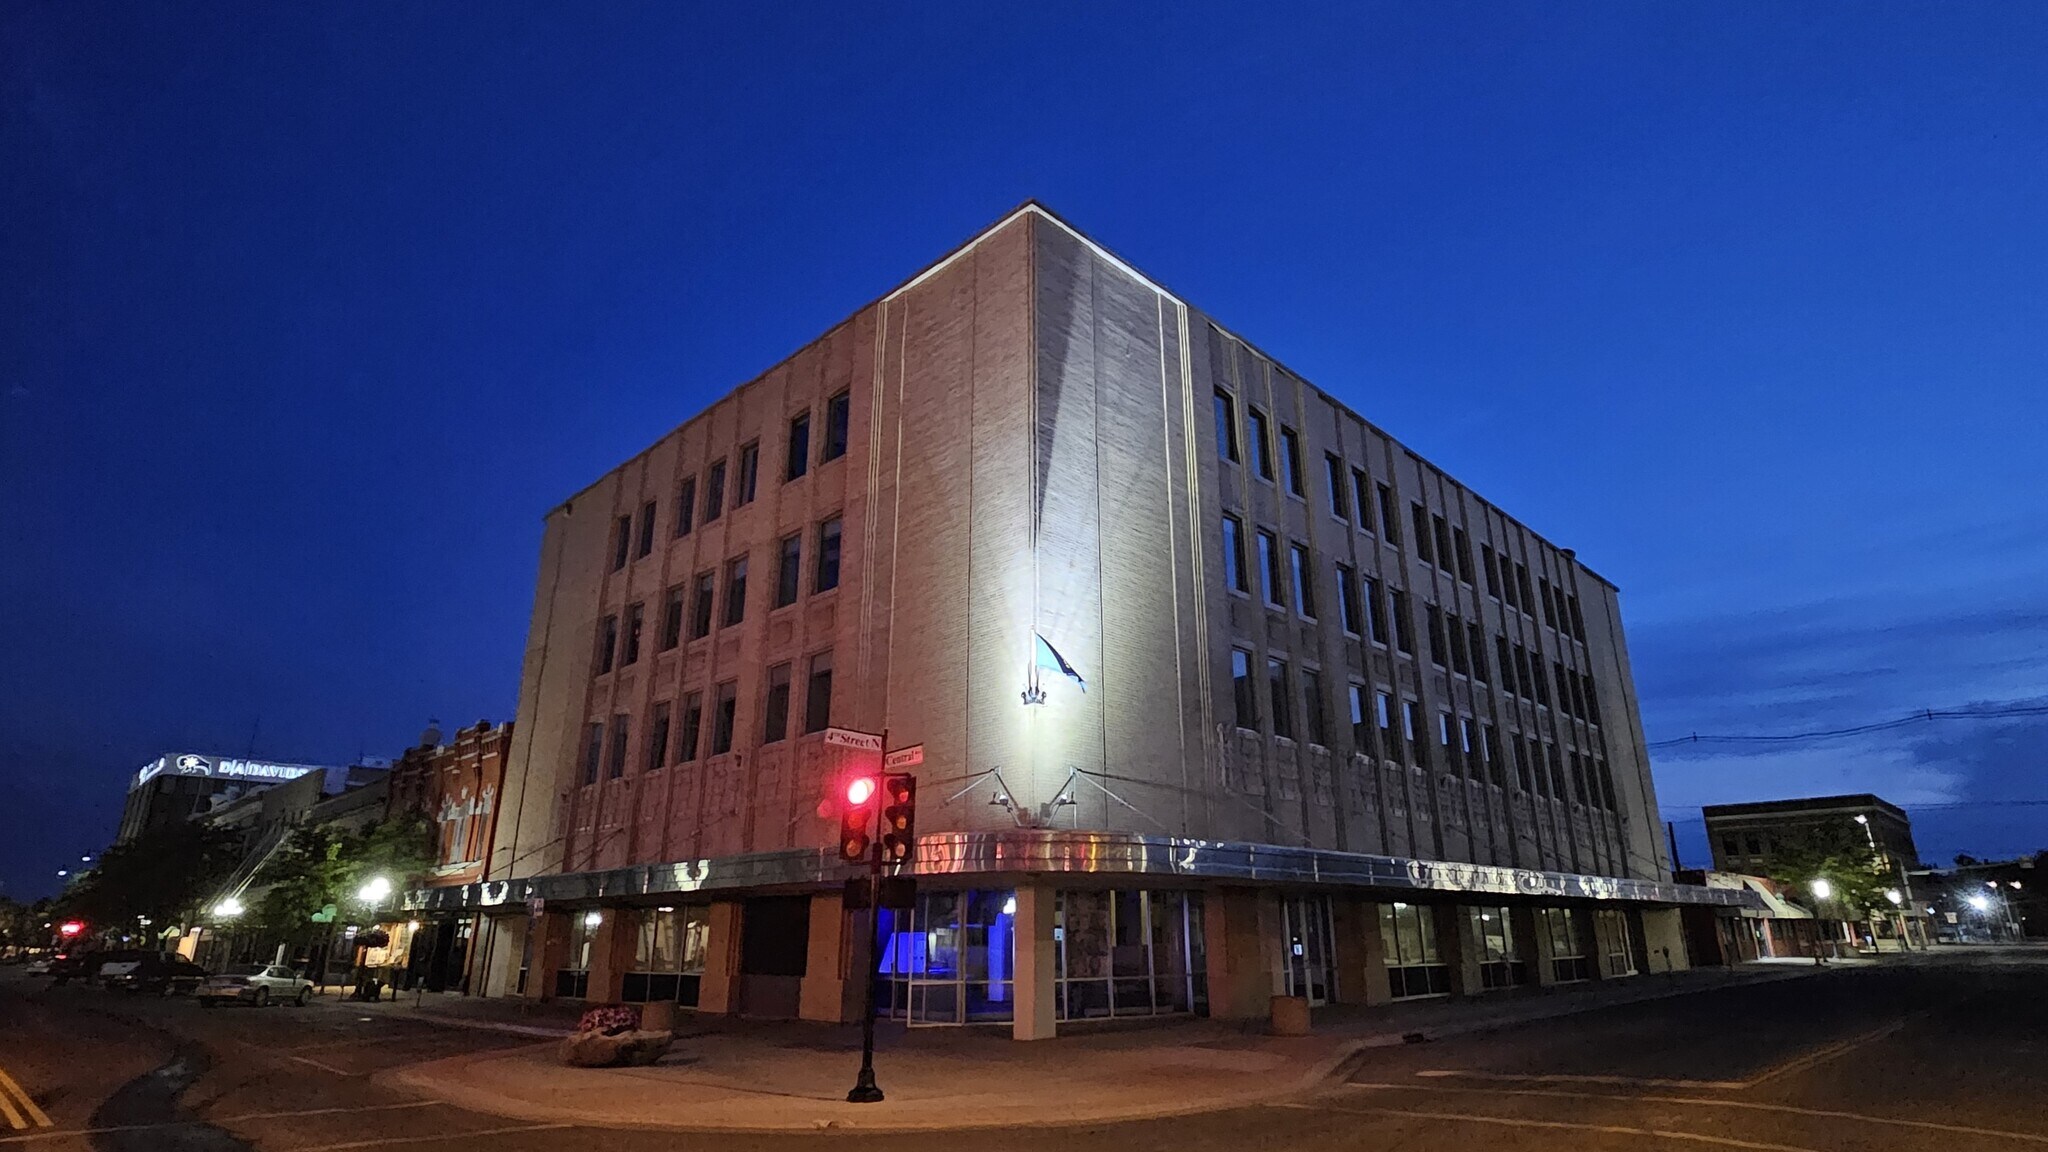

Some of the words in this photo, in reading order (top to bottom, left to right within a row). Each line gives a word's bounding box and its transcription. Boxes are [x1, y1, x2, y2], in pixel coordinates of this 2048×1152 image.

[840, 733, 869, 747] Street
[871, 738, 881, 748] N
[886, 750, 914, 766] Central
